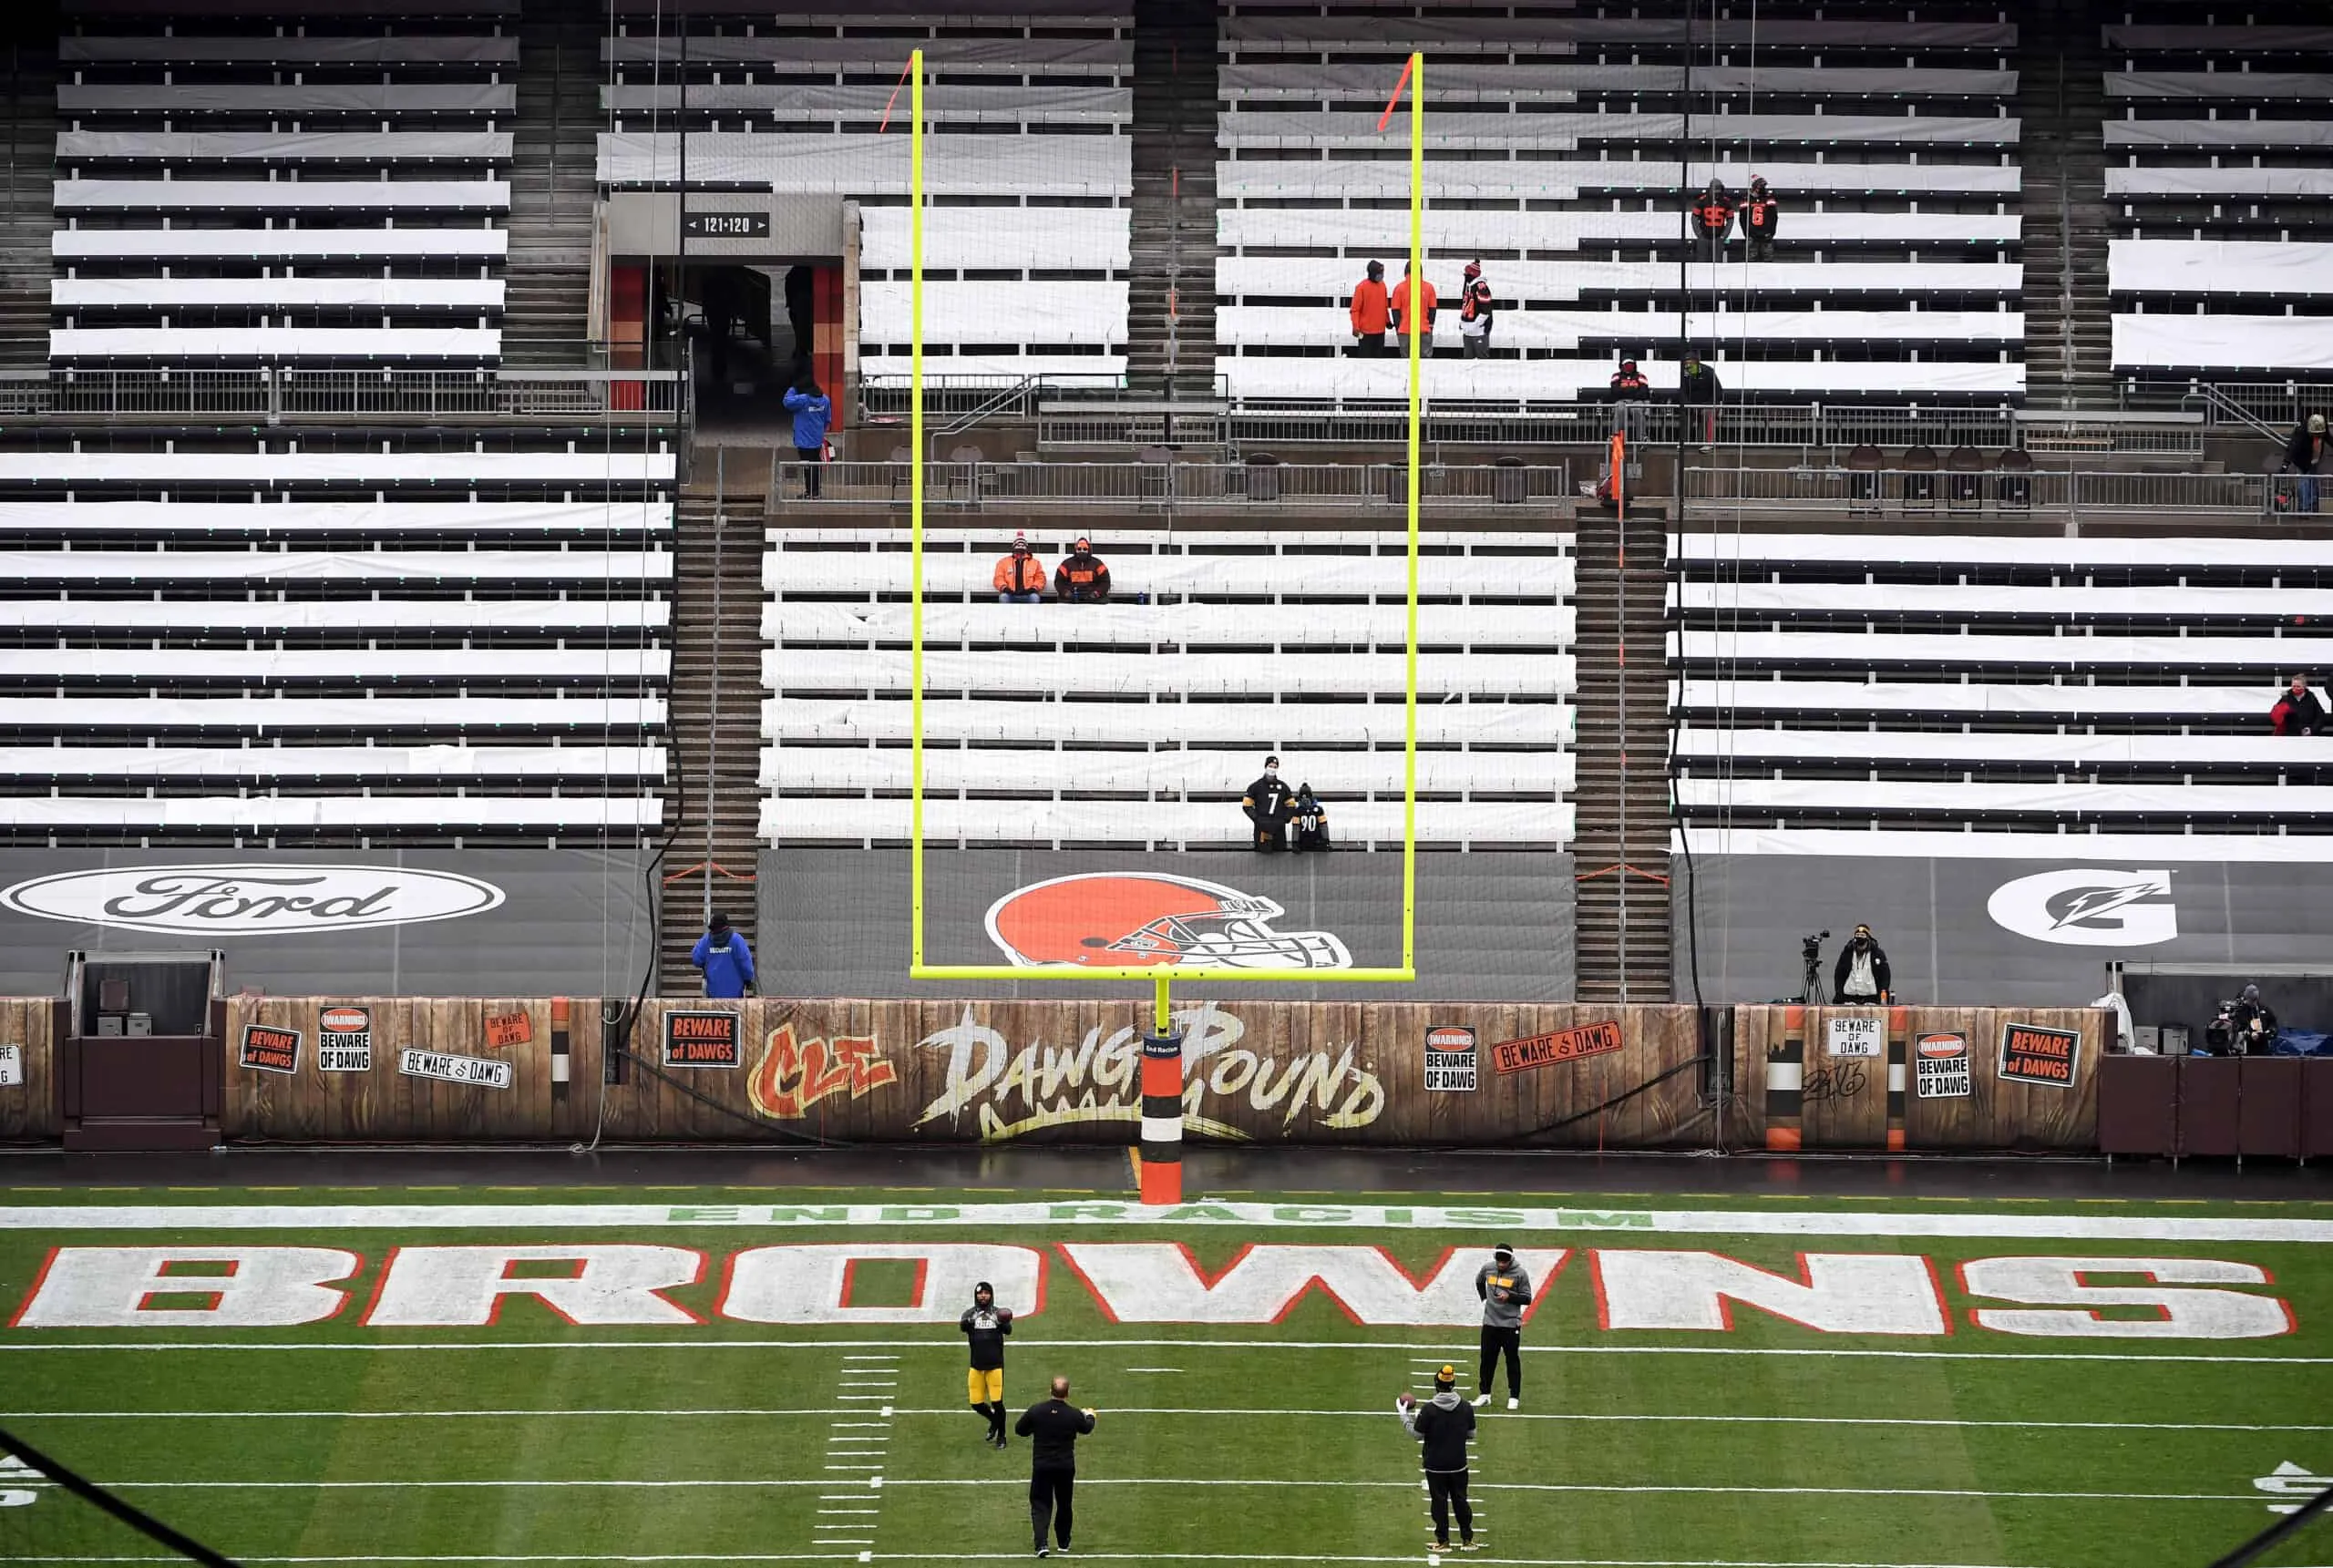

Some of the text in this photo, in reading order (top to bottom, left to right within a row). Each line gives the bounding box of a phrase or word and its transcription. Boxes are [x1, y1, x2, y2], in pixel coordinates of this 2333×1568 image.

[1752, 206, 1763, 226] 6
[1268, 793, 1280, 815] 7
[1300, 815, 1317, 832] 90
[103, 875, 401, 919] Ford
[490, 1013, 523, 1029] BEWARE
[673, 1018, 731, 1037] BEWARE
[1835, 1020, 1875, 1033] BEWARE
[250, 1030, 294, 1050] BEWARE
[320, 1034, 369, 1048] BEWARE
[498, 1031, 521, 1044] DAWG
[1502, 1025, 1613, 1068] BEWARE OF DAWG
[1848, 1033, 1860, 1041] OF
[2011, 1031, 2071, 1056] BEWARE
[672, 1043, 733, 1061] of DAWGS
[1840, 1041, 1868, 1054] DAWG
[247, 1050, 293, 1068] of DAWGS
[321, 1050, 369, 1069] OF DAWG
[407, 1052, 503, 1083] BEWARE OF DAWG
[1426, 1053, 1475, 1068] BEWARE
[1918, 1058, 1968, 1075] BEWARE
[2007, 1057, 2069, 1080] of DAWGS
[747, 1021, 898, 1120] CLE
[1426, 1071, 1475, 1089] OF DAWG
[1919, 1076, 1968, 1095] OF DAWG
[669, 1204, 1654, 1227] END RACISM
[7, 1242, 2297, 1339] BROWNS
